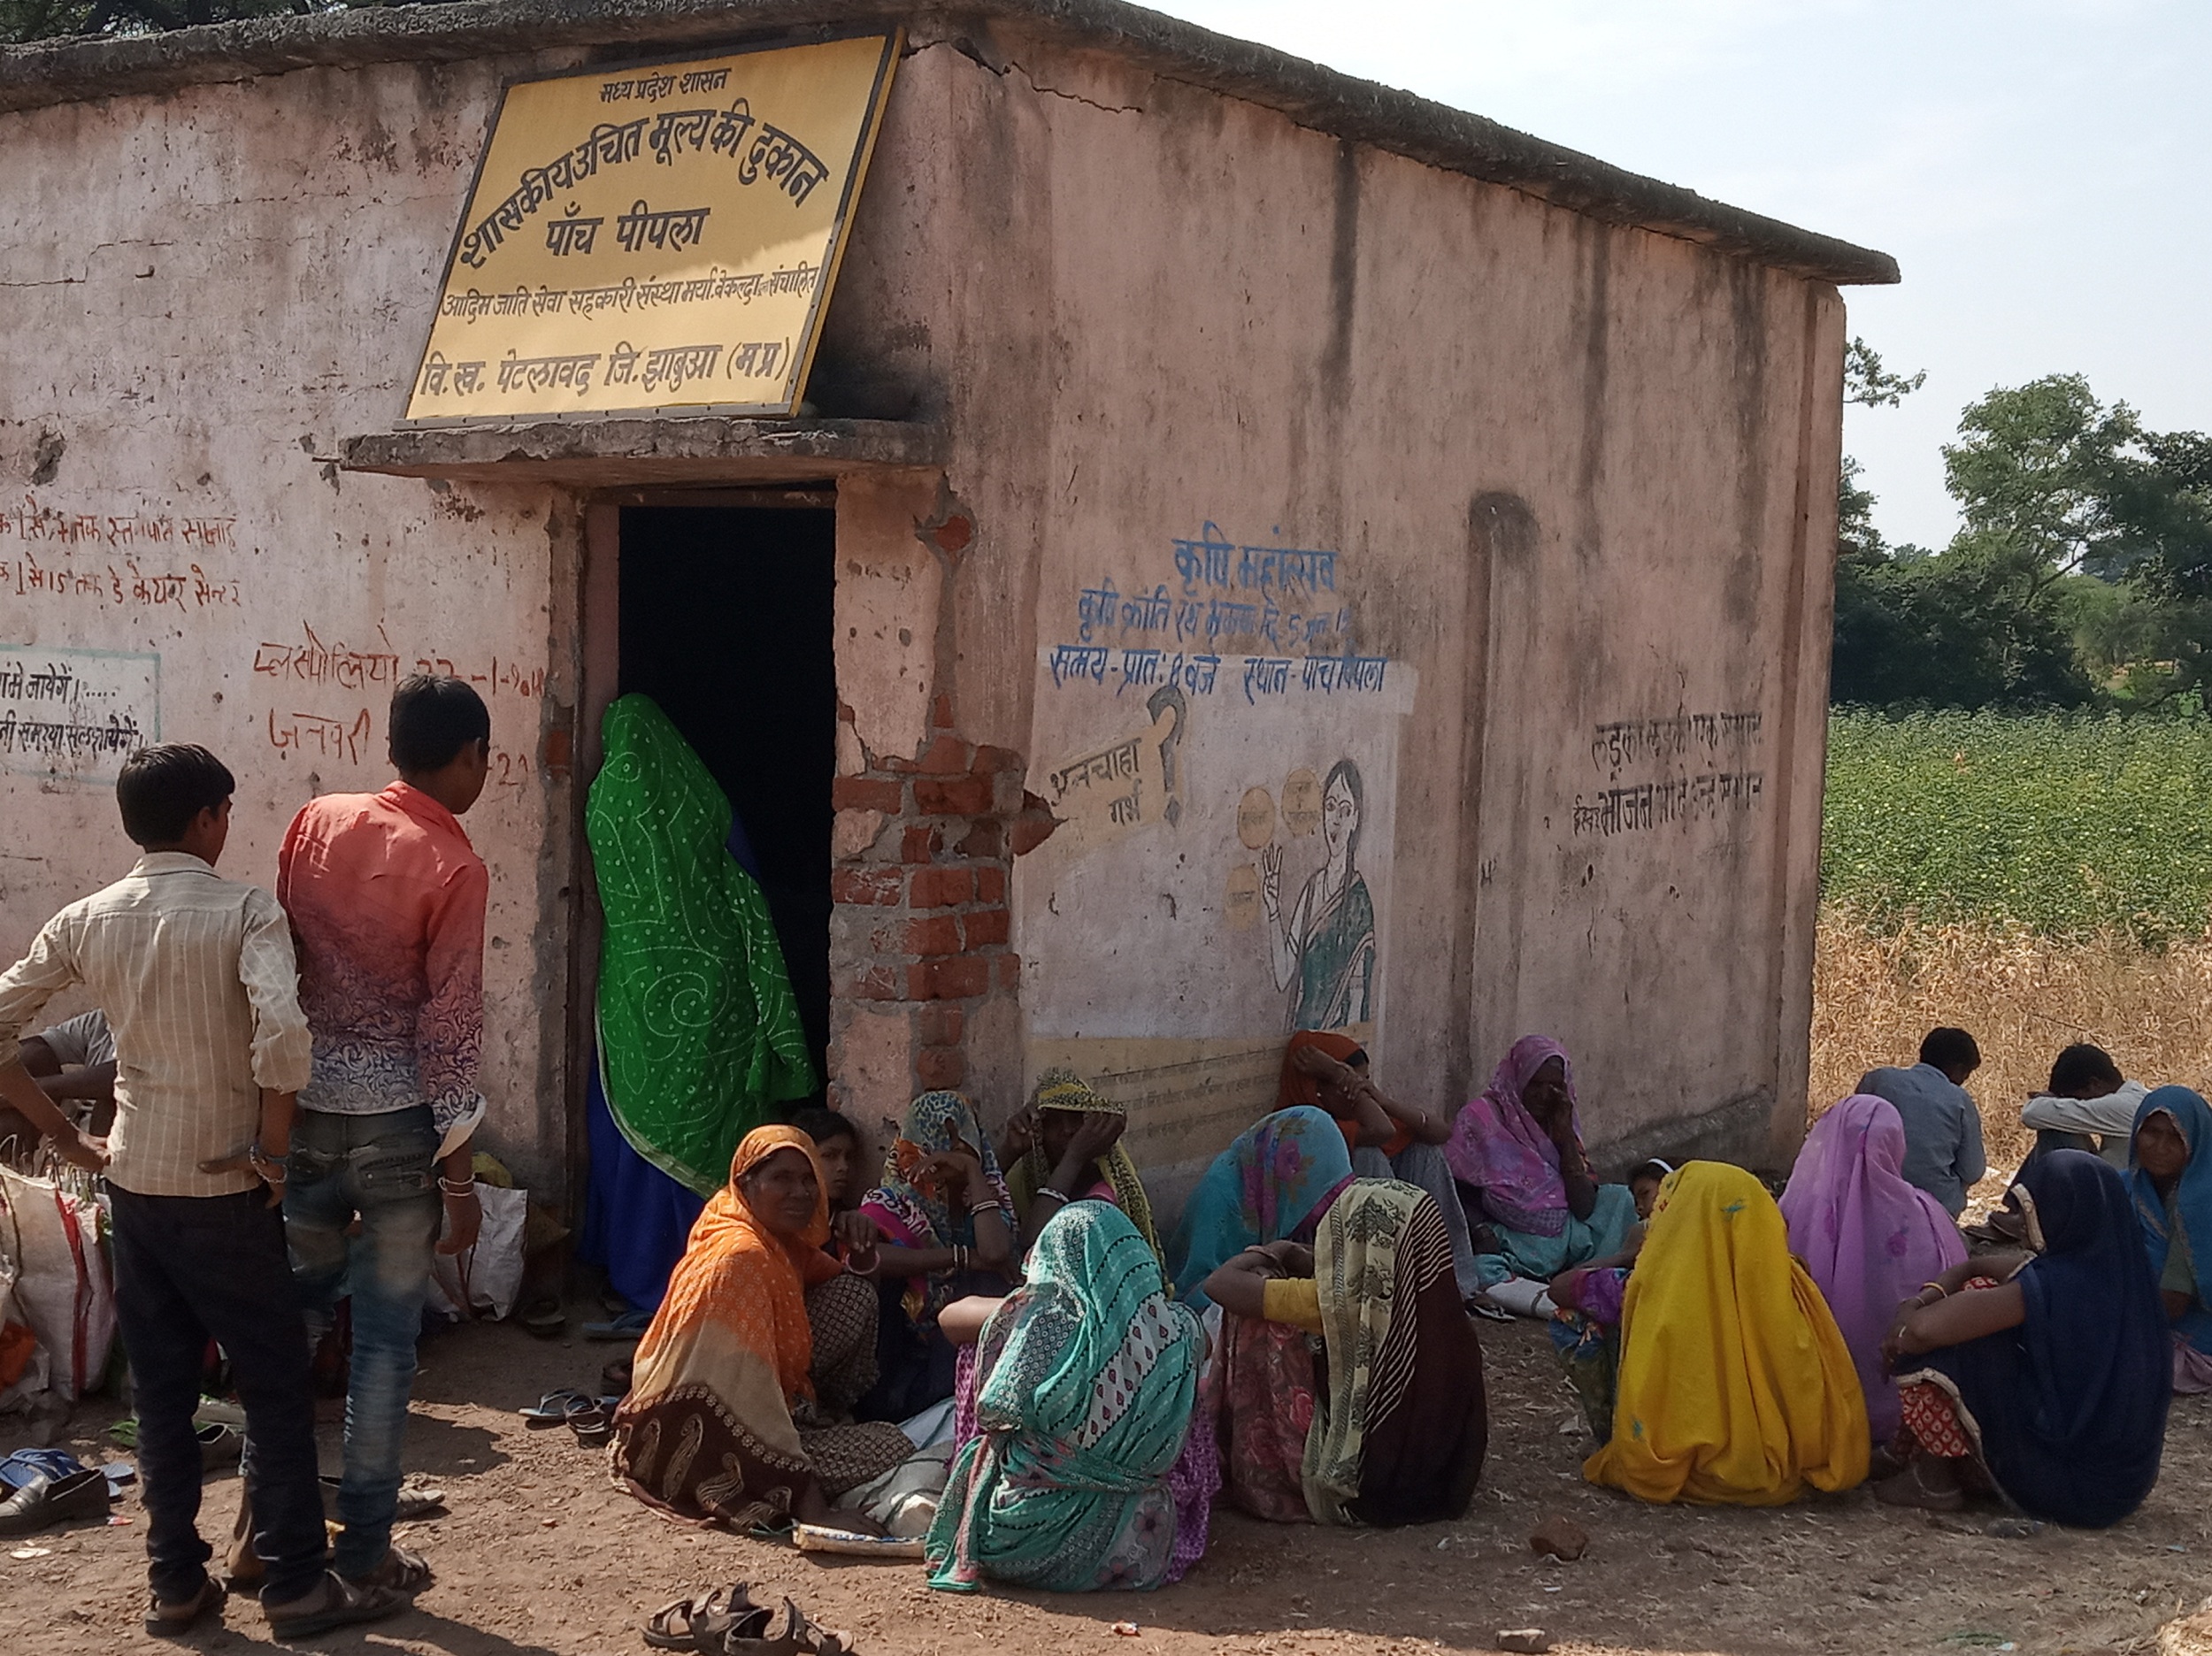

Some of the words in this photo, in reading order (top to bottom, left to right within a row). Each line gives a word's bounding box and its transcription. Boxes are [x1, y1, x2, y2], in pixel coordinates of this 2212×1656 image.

[601, 80, 634, 104] मध्य
[634, 71, 677, 103] प्रदेश
[680, 67, 732, 94] शासन
[460, 150, 574, 270] शासकीय
[572, 117, 650, 180] उचित
[649, 109, 718, 166] मूल्य
[710, 97, 757, 158] की
[738, 122, 830, 208] दुकान
[546, 201, 604, 257] पाँच
[617, 199, 711, 252] पीपला
[442, 288, 495, 325] आदिम
[494, 285, 532, 317] जाति
[533, 285, 568, 317] सेवा
[569, 276, 637, 321] सहकारी
[637, 275, 684, 310] संस्था
[769, 260, 820, 299] संचालित
[497, 348, 602, 397] पेटलावद
[641, 344, 724, 393] झाबुआ
